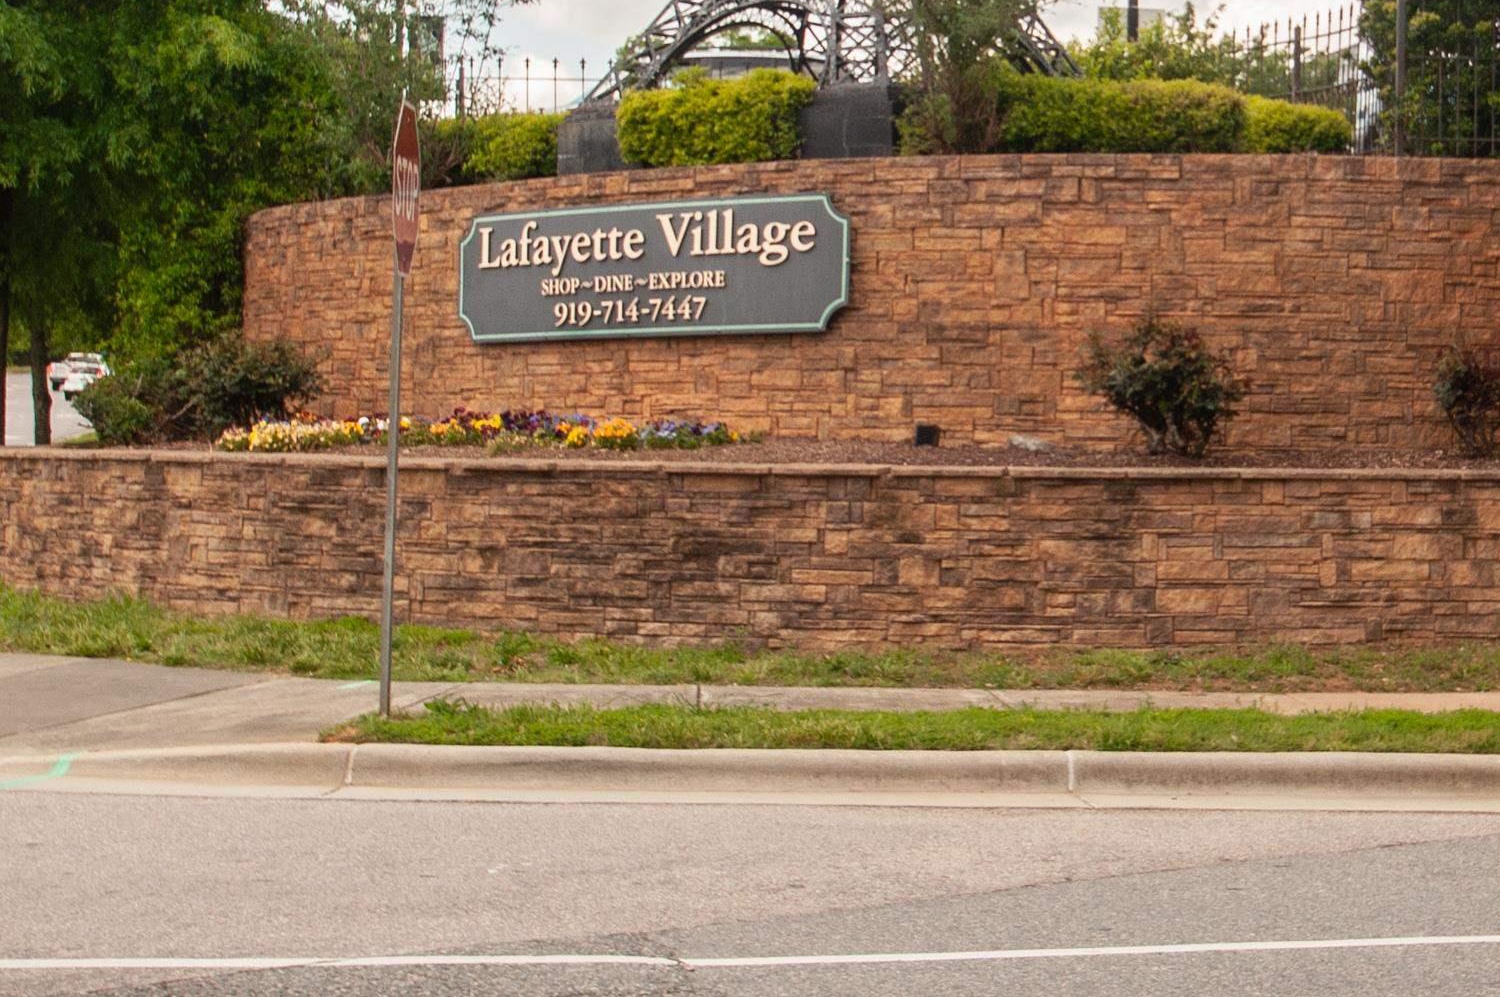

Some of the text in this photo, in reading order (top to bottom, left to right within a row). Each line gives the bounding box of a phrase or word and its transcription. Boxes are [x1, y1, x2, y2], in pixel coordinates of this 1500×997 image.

[396, 155, 419, 222] STOP
[478, 209, 816, 275] Lafayette Village
[554, 295, 707, 327] 919-714-7447
